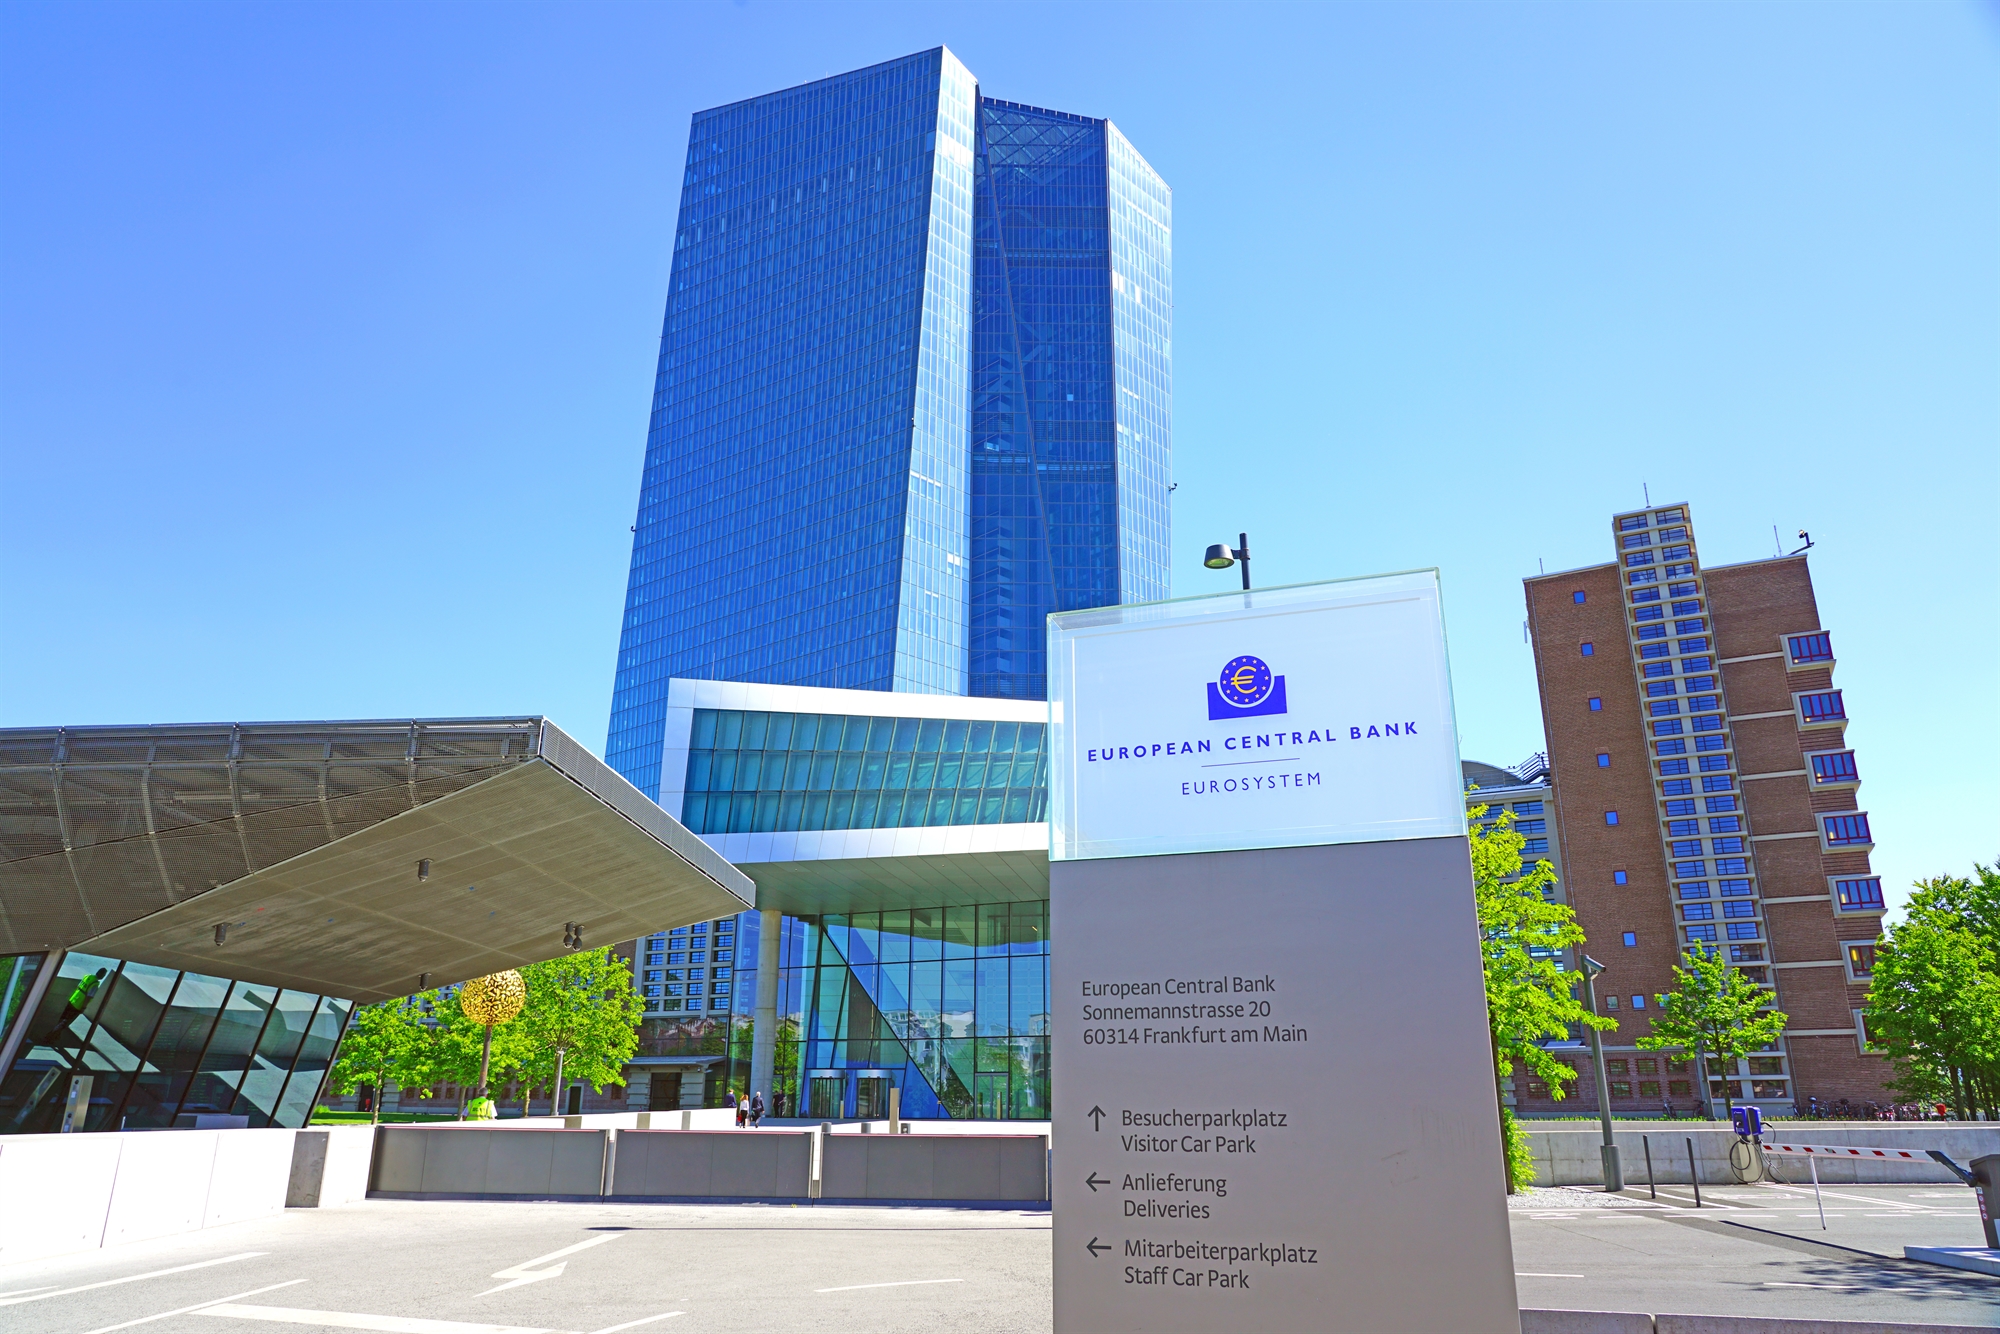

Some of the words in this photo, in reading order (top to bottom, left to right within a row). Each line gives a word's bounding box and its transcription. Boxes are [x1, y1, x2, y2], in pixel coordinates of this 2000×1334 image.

[1087, 738, 1212, 762] EUROPEAN
[1224, 728, 1337, 751] CENTRAL
[1349, 720, 1419, 740] BANK
[1181, 771, 1322, 796] EUROSYSTEM
[1082, 979, 1161, 999] European
[1164, 976, 1228, 995] Central
[1232, 974, 1276, 993] Bank
[1082, 1004, 1245, 1021] Sonnemannstrasse
[1248, 1001, 1271, 1018] 20
[1082, 1028, 1140, 1045] 60314
[1143, 1026, 1227, 1045] Frankfurt
[1230, 1028, 1259, 1043] am
[1263, 1024, 1308, 1042] Main
[1121, 1108, 1288, 1133] Besucherparkplatz
[1120, 1134, 1179, 1153] Visitor
[1180, 1136, 1212, 1153] Car
[1215, 1135, 1257, 1154] Park
[1121, 1172, 1227, 1197] Anlieferung
[1124, 1199, 1211, 1219] Deliveries
[1124, 1238, 1318, 1266] Mitarbeiterparkplatz
[1124, 1266, 1169, 1286] Staff
[1172, 1269, 1204, 1287] Car
[1207, 1269, 1250, 1289] Park
